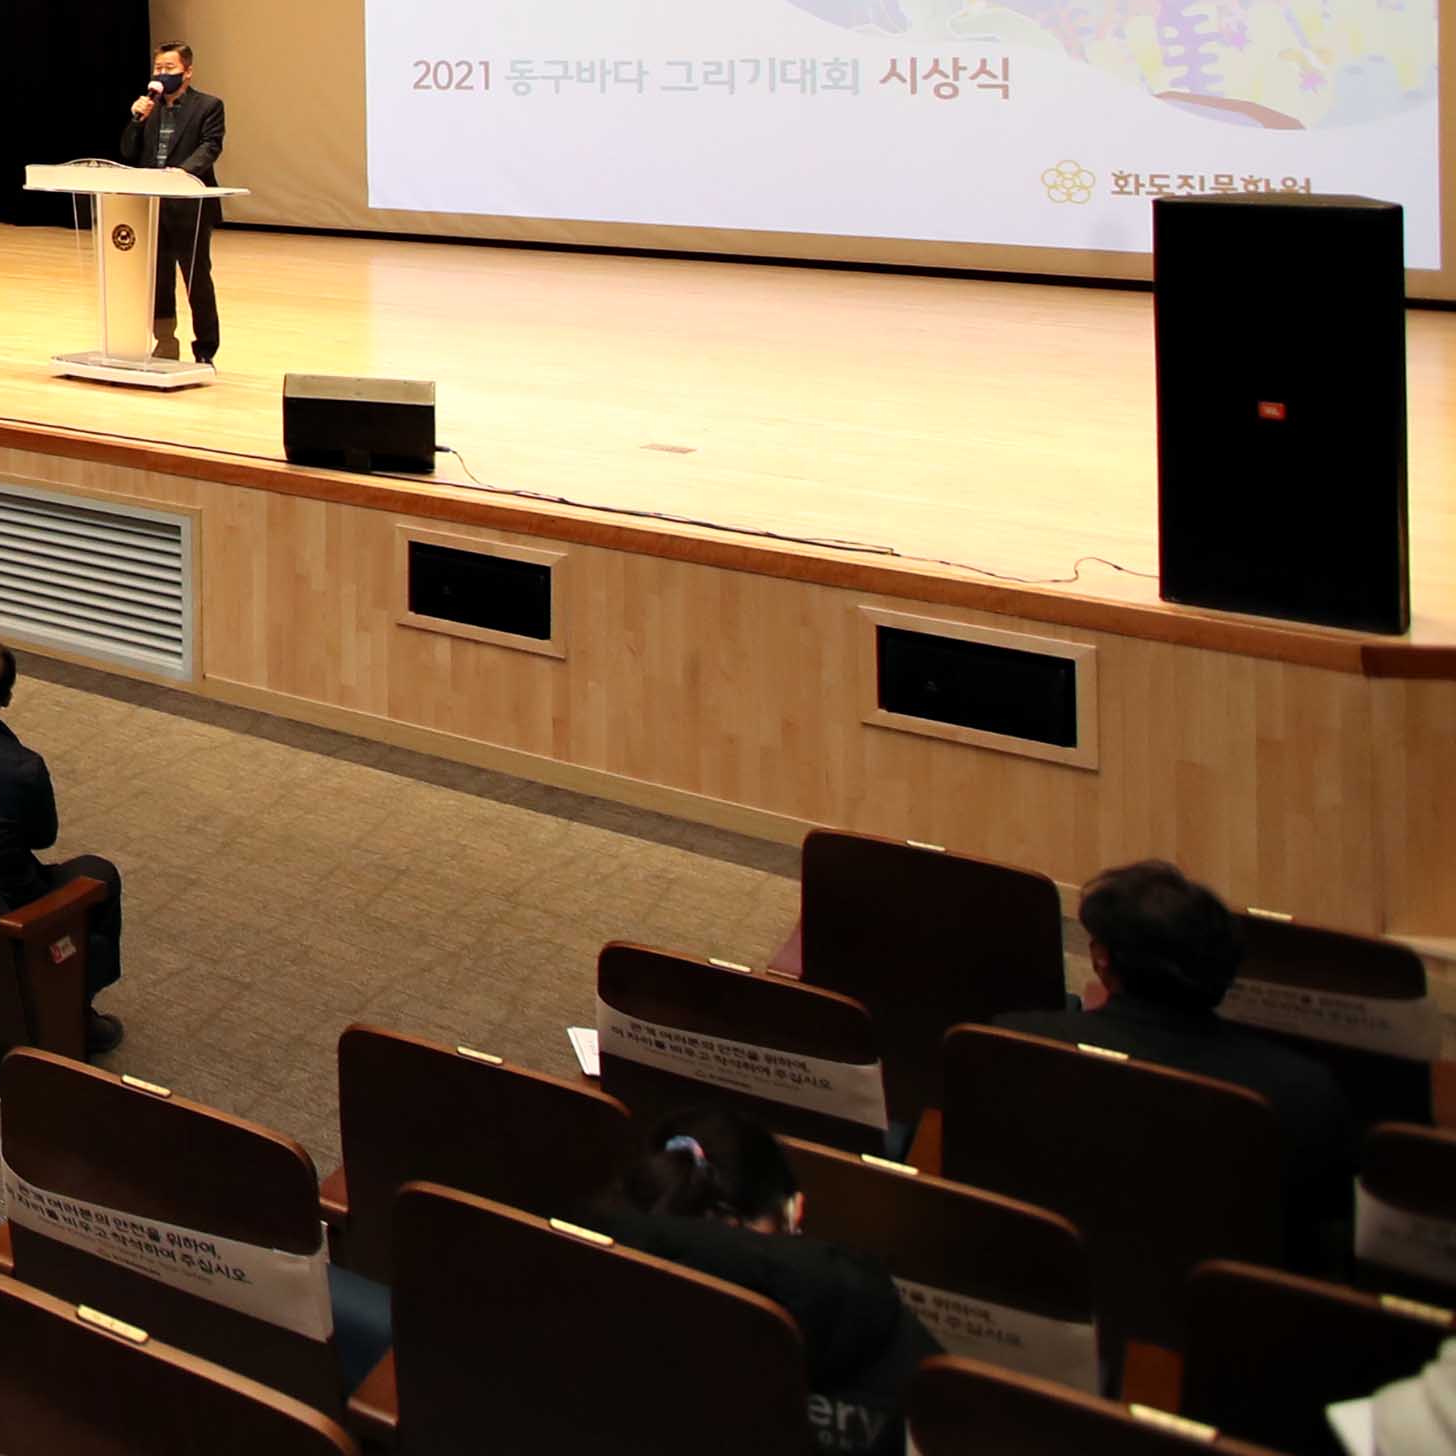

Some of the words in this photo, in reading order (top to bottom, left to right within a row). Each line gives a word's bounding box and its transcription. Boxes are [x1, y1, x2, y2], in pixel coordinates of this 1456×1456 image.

[412, 59, 492, 92] 2021
[504, 58, 649, 96] 동구바다
[660, 57, 862, 96] 그리기대회
[879, 56, 1011, 101] 시상식
